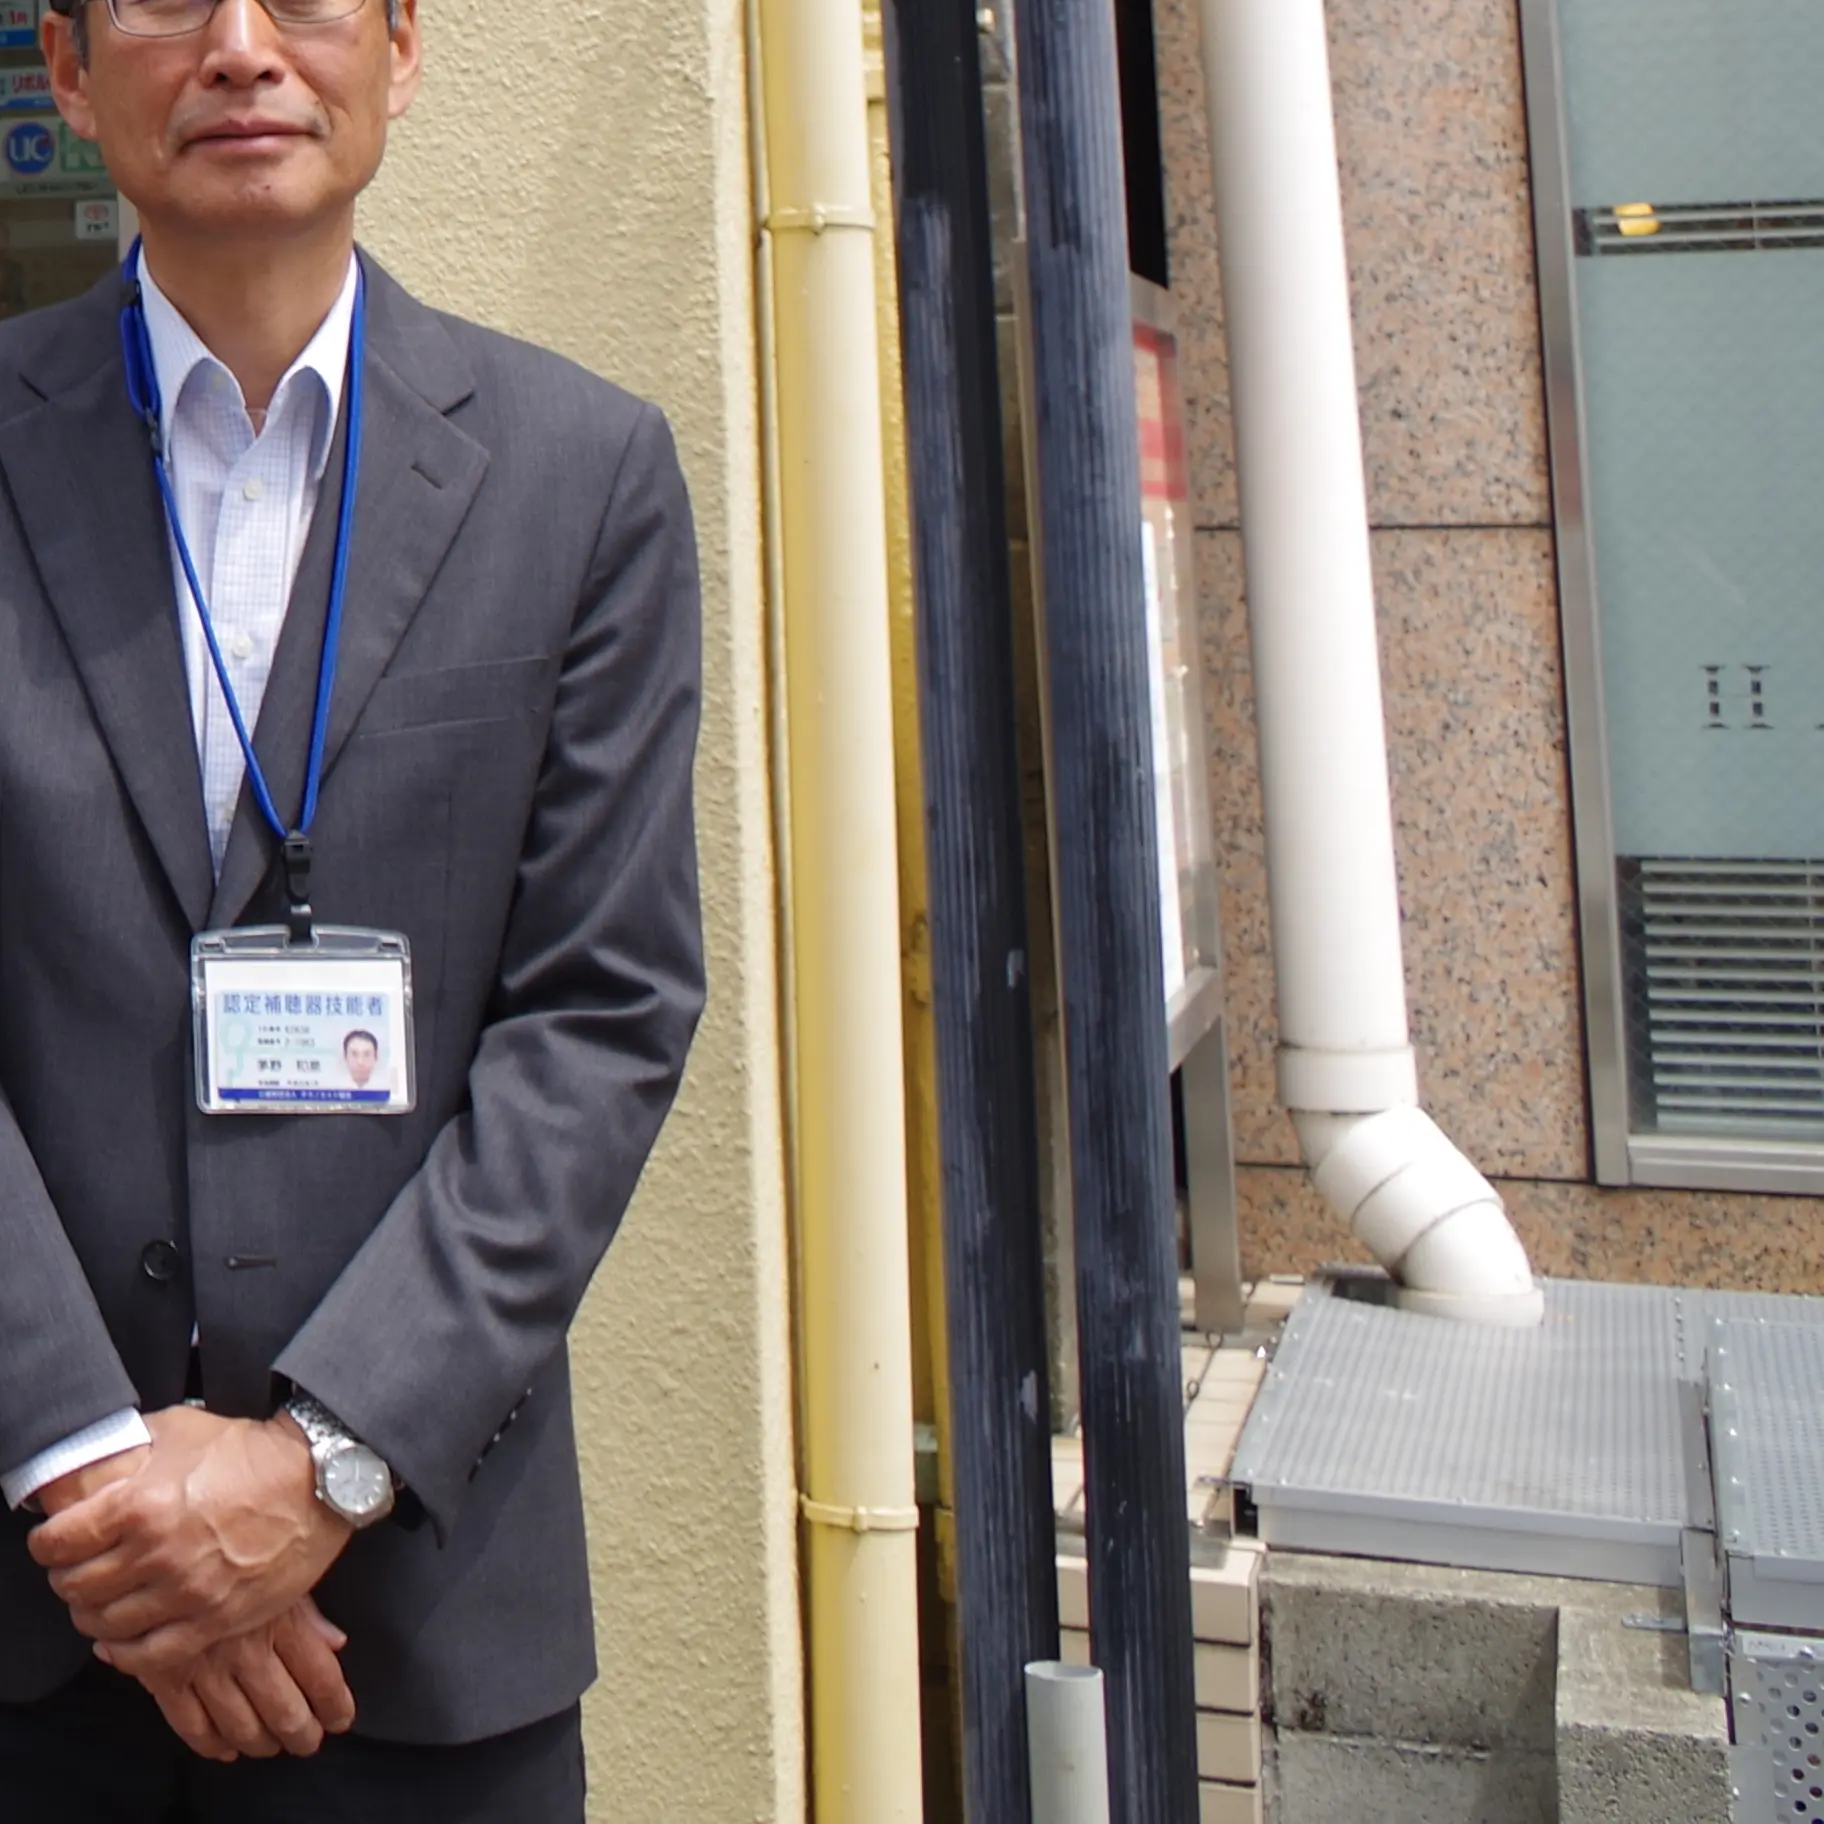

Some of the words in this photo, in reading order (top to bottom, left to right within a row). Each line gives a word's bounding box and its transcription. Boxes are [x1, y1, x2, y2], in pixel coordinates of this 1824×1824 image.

[222, 992, 384, 1018] 認定補聴器技能者
